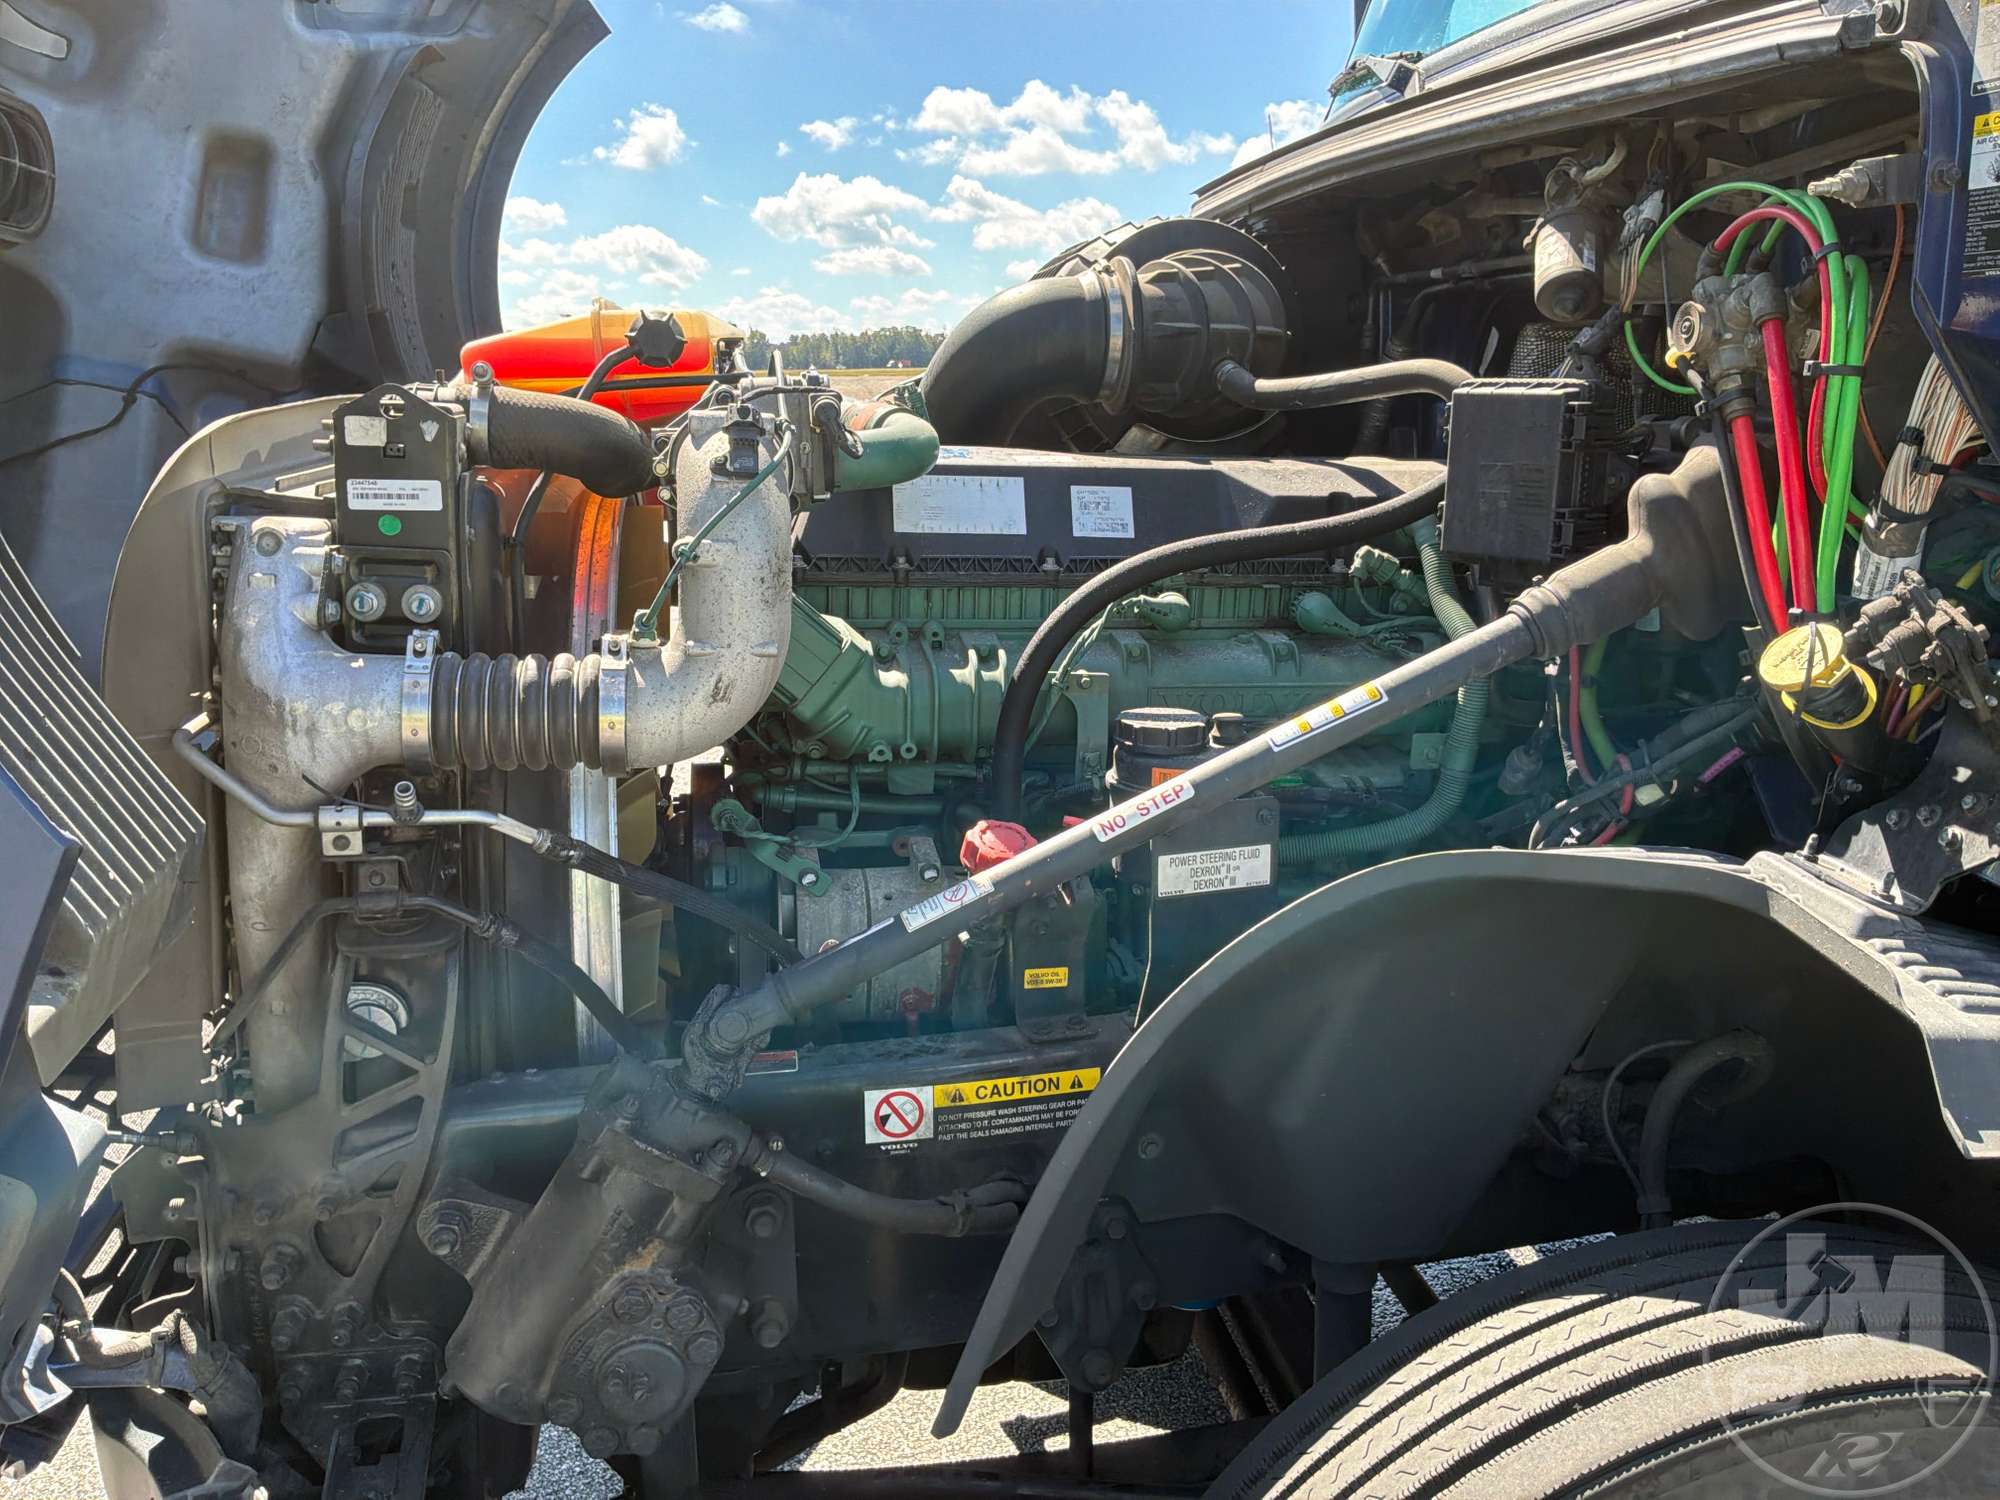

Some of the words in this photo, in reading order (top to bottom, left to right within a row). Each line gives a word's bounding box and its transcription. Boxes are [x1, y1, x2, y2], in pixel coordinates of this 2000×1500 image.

[1099, 815, 1127, 836] NO
[1136, 784, 1185, 817] STEP
[1169, 855, 1197, 868] POWER
[1199, 850, 1237, 865] STEERING
[1239, 848, 1261, 860] FLUID
[975, 1077, 1060, 1100] CAUTION
[938, 1114, 948, 1122] DO
[949, 1113, 962, 1121] NOT
[963, 1109, 997, 1119] PRESSURE
[998, 1107, 1016, 1116] WASH
[1017, 1103, 1048, 1114] STEERING
[1048, 1101, 1066, 1110] GEAR
[938, 1122, 972, 1132] ATTACHED
[991, 1114, 1040, 1126] CONTAMINANTS
[1041, 1112, 1054, 1120] MAY
[1055, 1110, 1064, 1118] BE
[938, 1133, 955, 1141] PAST
[956, 1131, 969, 1140] THE
[969, 1129, 990, 1139] SEALS
[990, 1125, 1024, 1137] DAMAGING
[1025, 1122, 1055, 1132] INTERNAL
[880, 1142, 918, 1151] VOLVO
